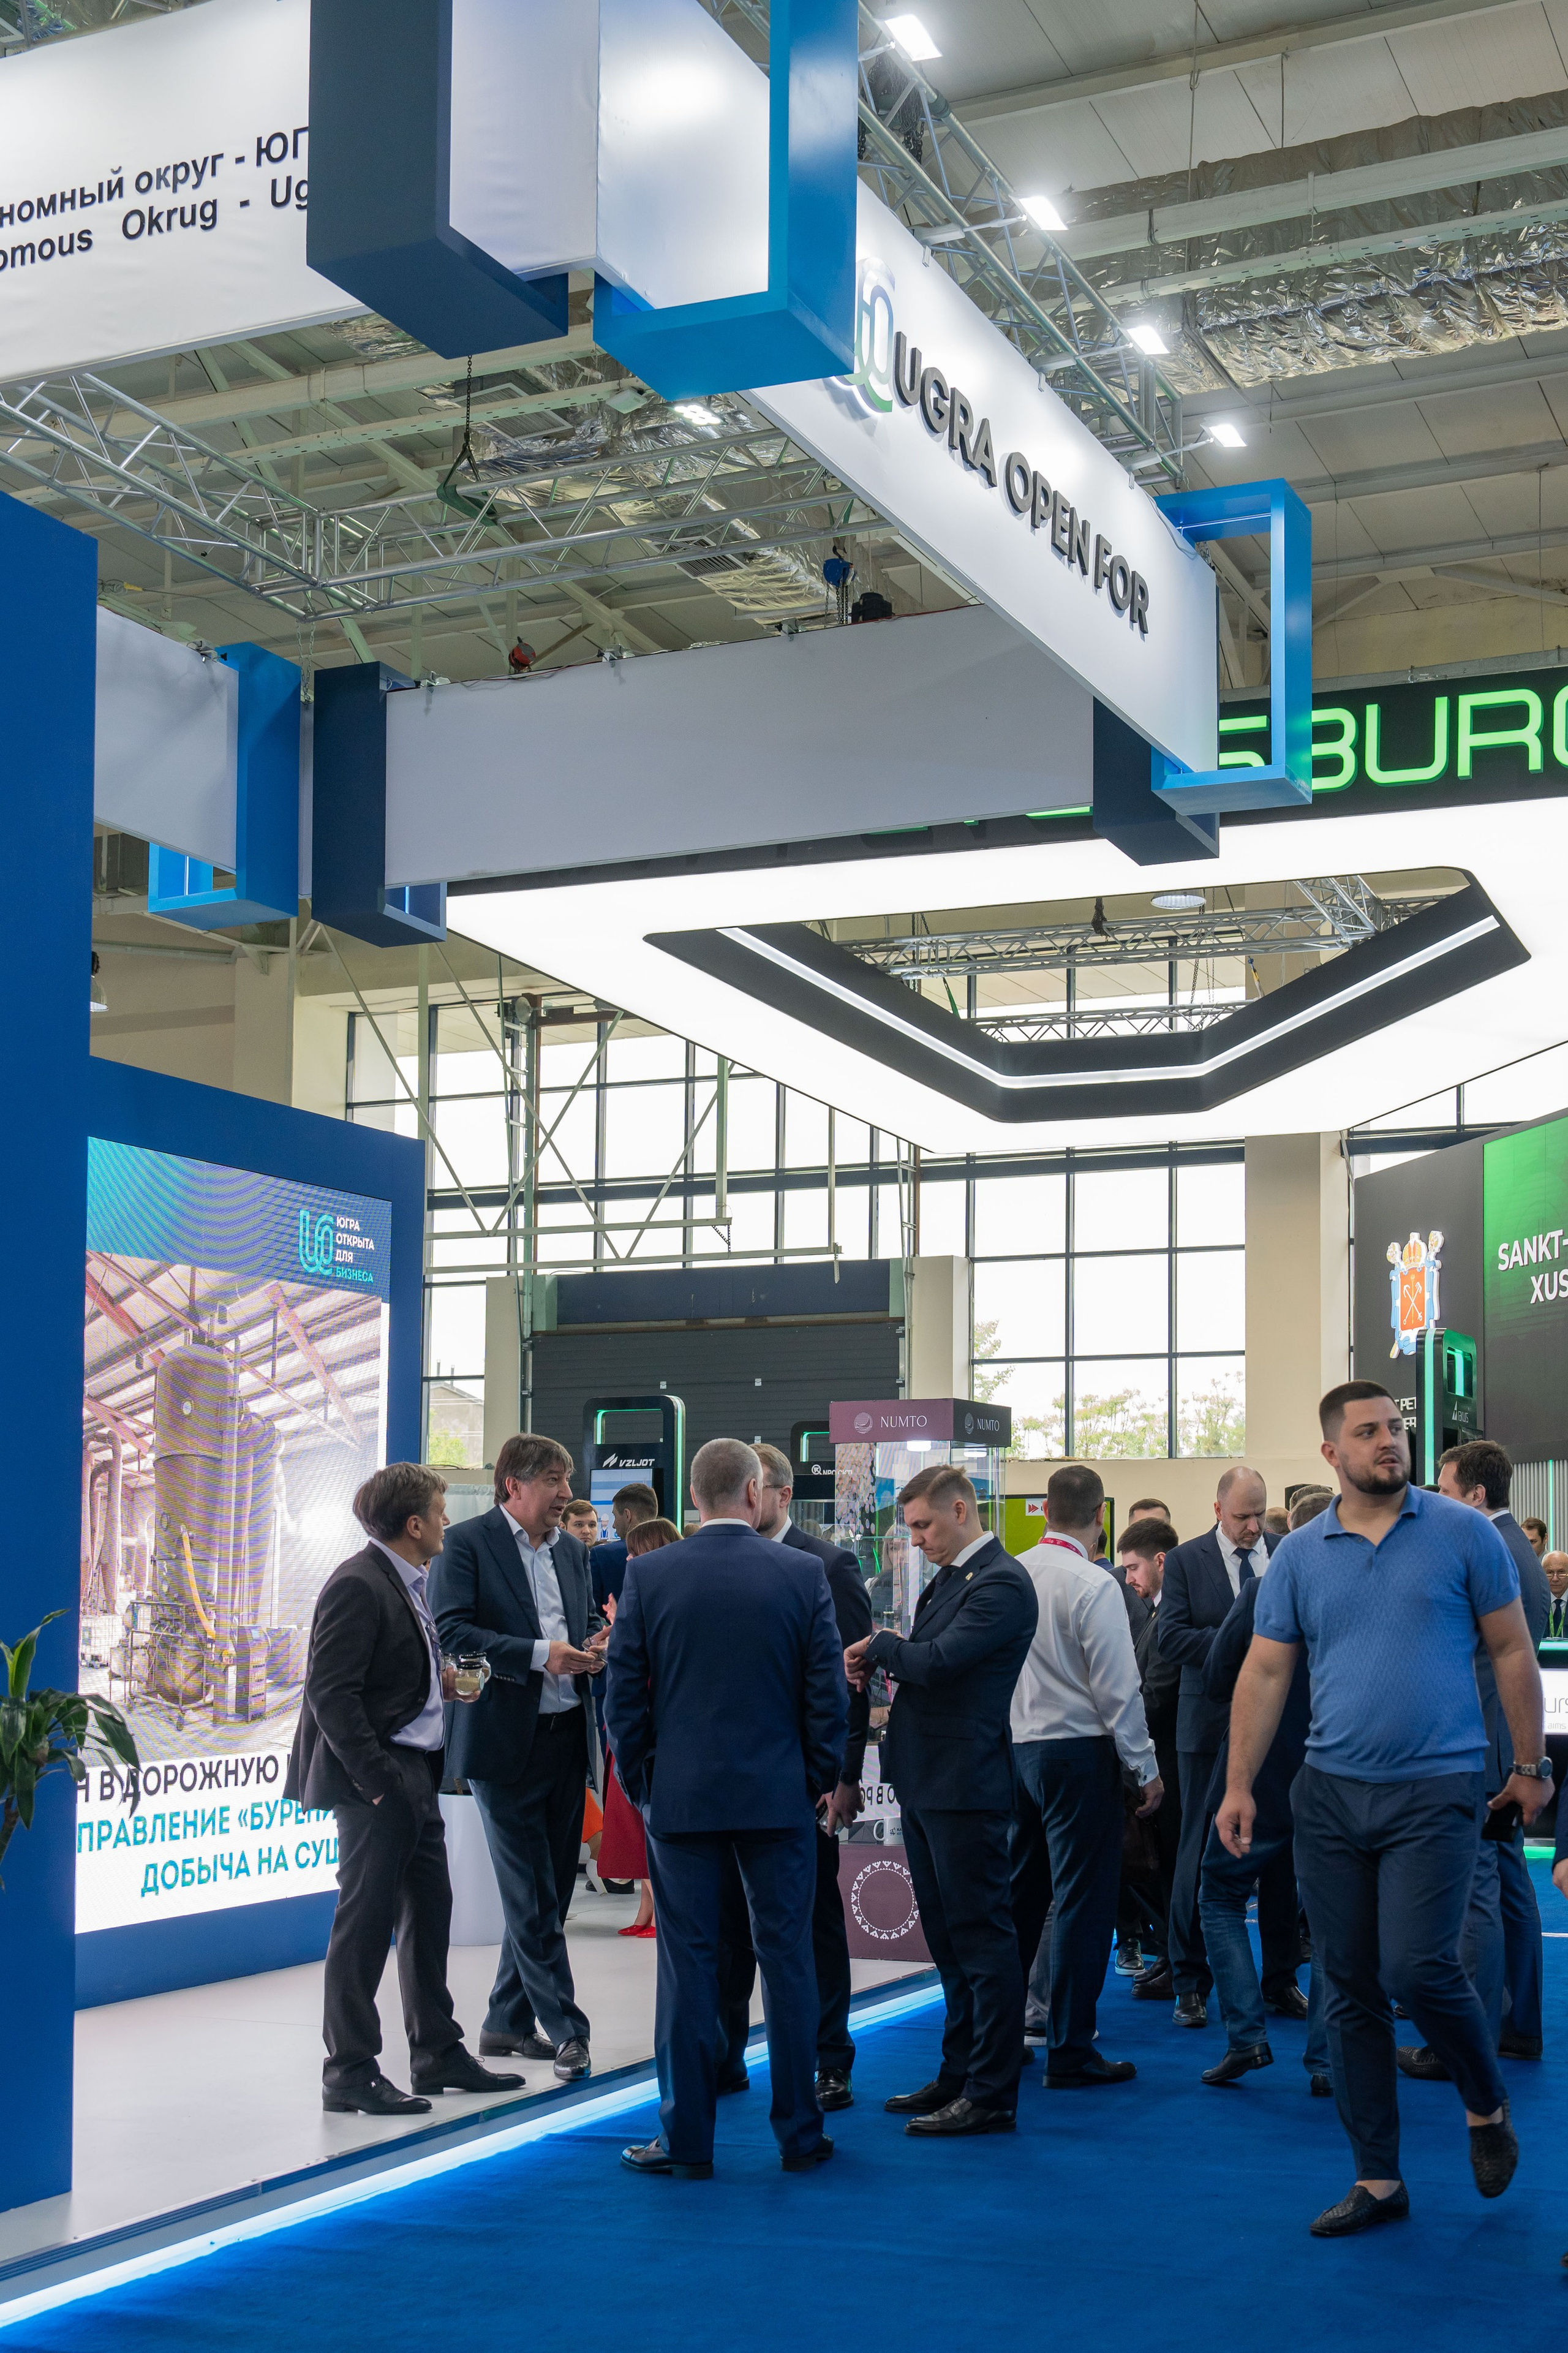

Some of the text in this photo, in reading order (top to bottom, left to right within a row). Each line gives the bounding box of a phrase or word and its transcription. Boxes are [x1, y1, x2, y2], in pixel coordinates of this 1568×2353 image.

[0, 166, 124, 228] номный
[134, 153, 224, 195] округ
[256, 126, 309, 167] ЮГ
[122, 198, 218, 241] Okrug
[271, 175, 307, 210] Ug
[893, 331, 1150, 634] UGRA OPEN FOR
[1219, 684, 1568, 793] BUR
[336, 1216, 360, 1231] ЮГРА
[335, 1249, 353, 1263] ДЛЯ
[336, 1233, 375, 1250] ОТКРЫТА
[335, 1266, 374, 1283] БИЗНЕСА
[1530, 1269, 1568, 1304] XUS
[880, 1415, 927, 1428] NUMTO
[977, 1418, 1000, 1432] NUMTO
[619, 1459, 655, 1467] VZLJOT
[123, 1754, 279, 1803] ДОРОЖНУЮ
[77, 1805, 231, 1854] ПРАВЛЕНИЕ
[141, 1850, 251, 1898] ДОБЫЧА
[258, 1845, 289, 1875] НА
